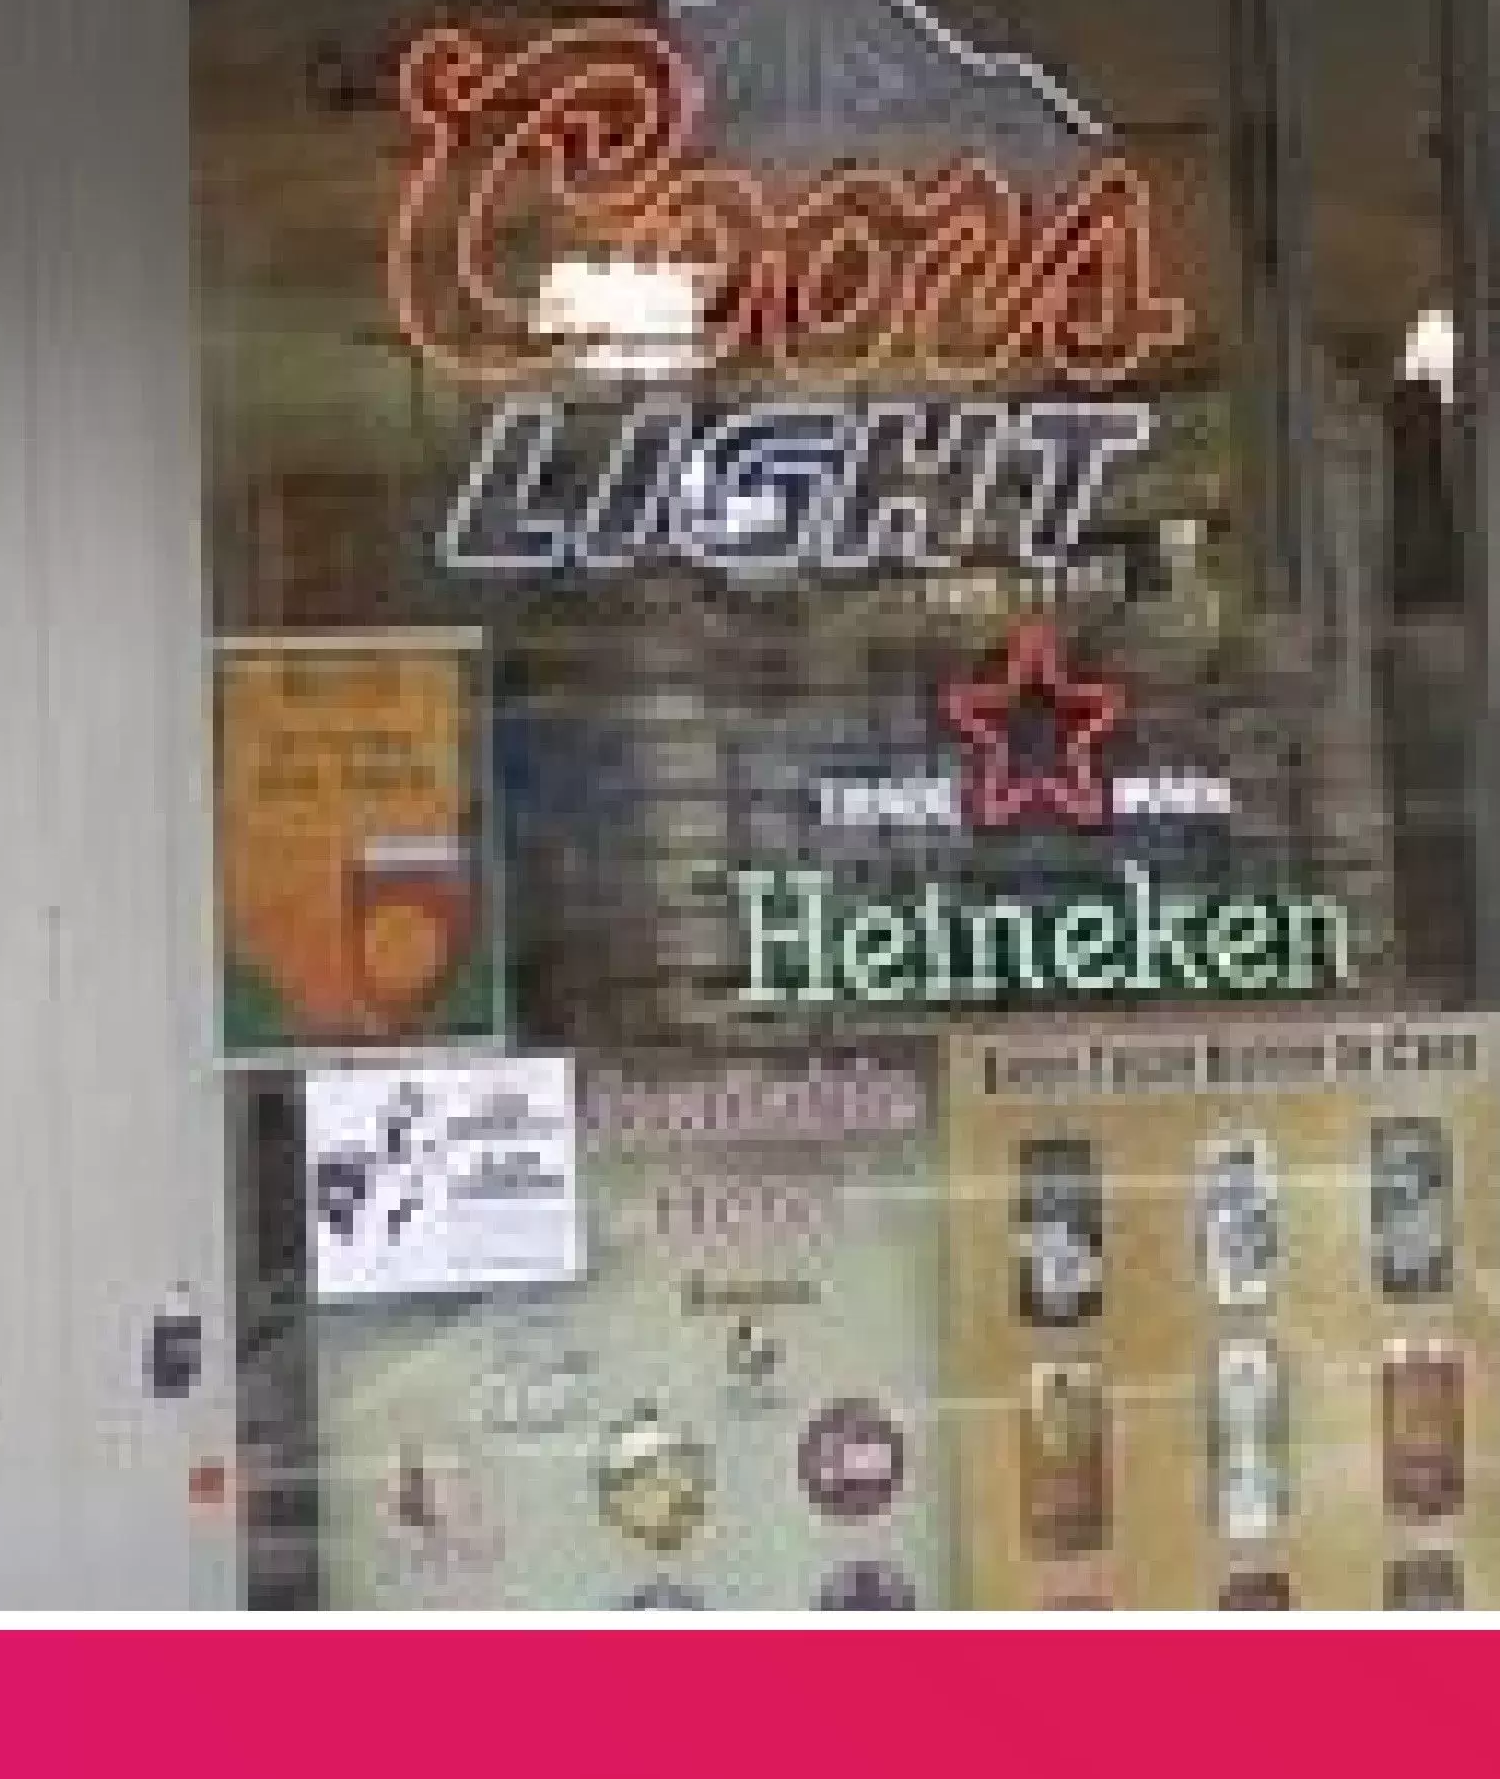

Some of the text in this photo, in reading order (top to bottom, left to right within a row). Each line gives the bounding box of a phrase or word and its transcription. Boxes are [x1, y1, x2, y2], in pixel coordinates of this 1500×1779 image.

[384, 17, 1192, 386] Coors
[434, 400, 1160, 572] LIGHT
[735, 862, 1356, 1004] Heineken
